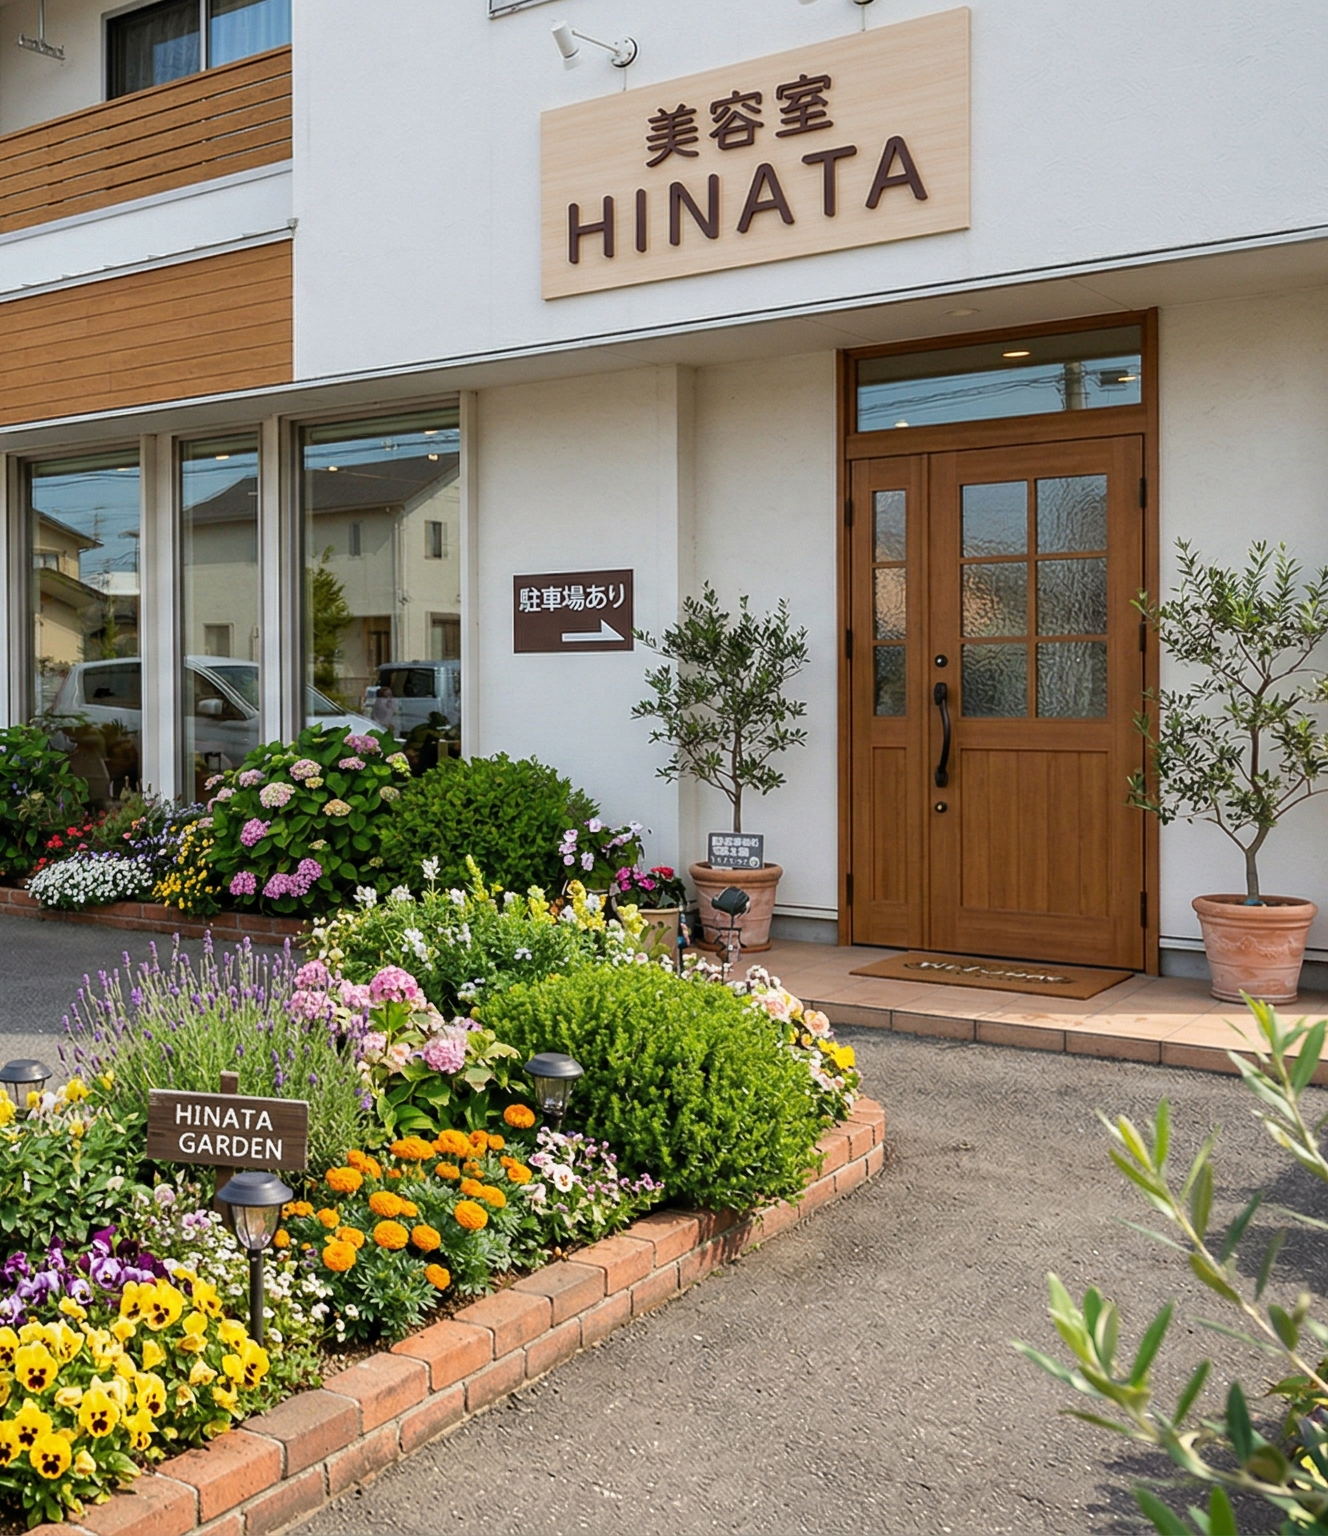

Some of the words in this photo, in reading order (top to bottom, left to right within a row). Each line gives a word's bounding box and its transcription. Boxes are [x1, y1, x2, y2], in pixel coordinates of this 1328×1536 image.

[645, 73, 834, 168] 美容室
[567, 135, 928, 264] HINATA
[519, 583, 625, 613] 駐車場あり
[175, 1103, 274, 1131] HINATA
[178, 1132, 283, 1161] GARDEN
